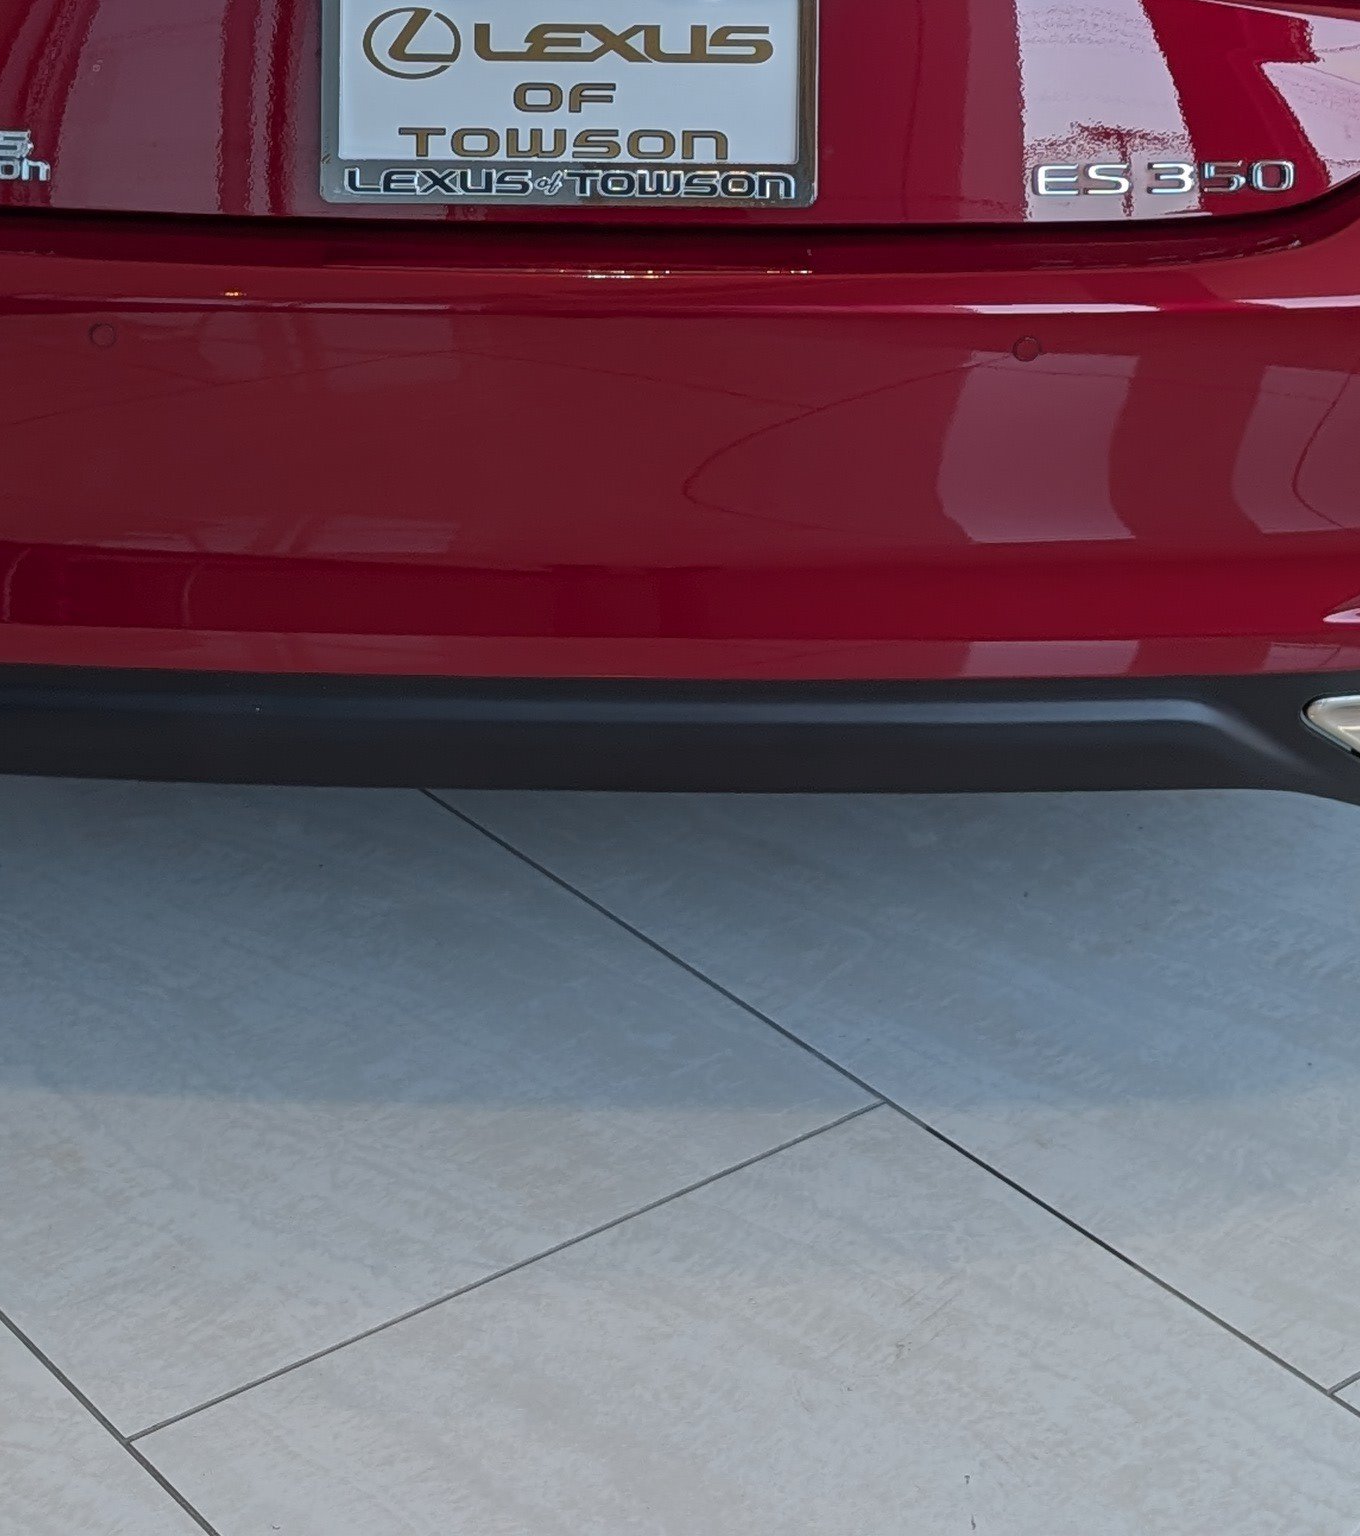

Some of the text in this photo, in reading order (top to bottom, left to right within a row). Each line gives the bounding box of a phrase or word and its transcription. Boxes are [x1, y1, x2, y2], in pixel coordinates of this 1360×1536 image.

[473, 22, 775, 64] LEXUS
[512, 81, 617, 114] OF
[397, 126, 729, 161] TOWSON
[344, 167, 532, 196] LEXUS
[564, 168, 796, 201] TOWSON
[1034, 159, 1297, 195] ES 350
